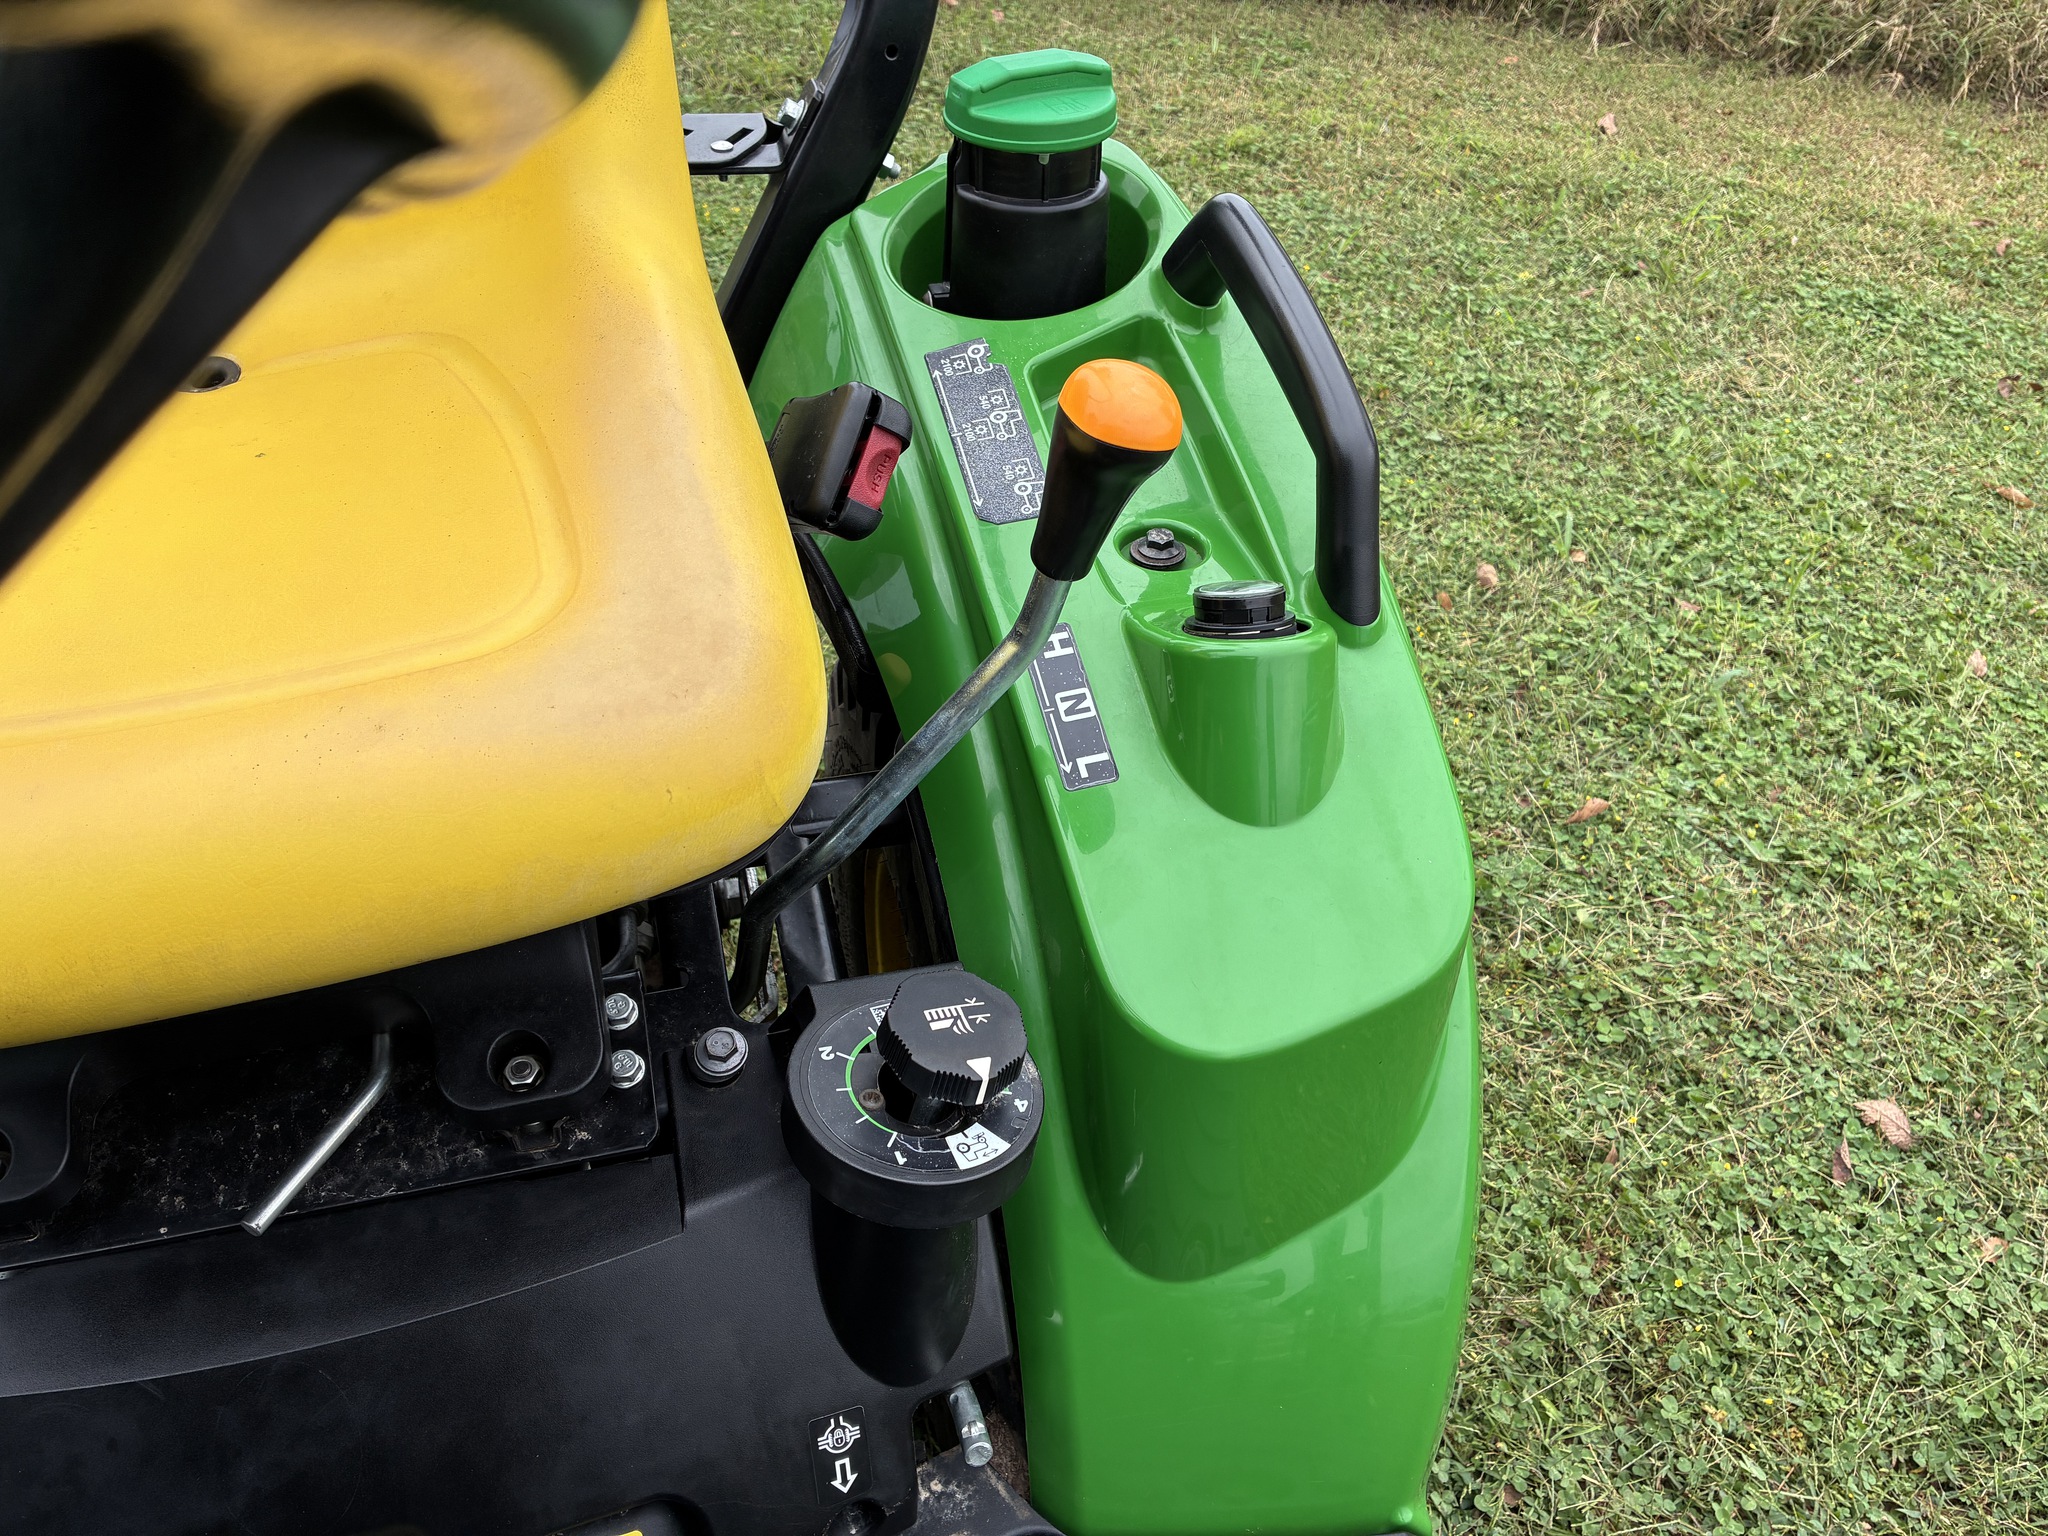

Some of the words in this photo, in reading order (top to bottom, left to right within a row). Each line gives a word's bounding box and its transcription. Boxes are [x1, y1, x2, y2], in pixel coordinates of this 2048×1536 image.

[941, 358, 954, 377] 2100
[979, 395, 991, 409] 540
[962, 423, 976, 442] 2100
[871, 453, 892, 494] PUSH
[1002, 465, 1015, 480] 540
[1044, 631, 1074, 659] H
[1060, 692, 1092, 717] N
[1076, 752, 1110, 779] L
[818, 1046, 835, 1061] 2
[1014, 1098, 1029, 1113] 4
[894, 1150, 908, 1166] 1
